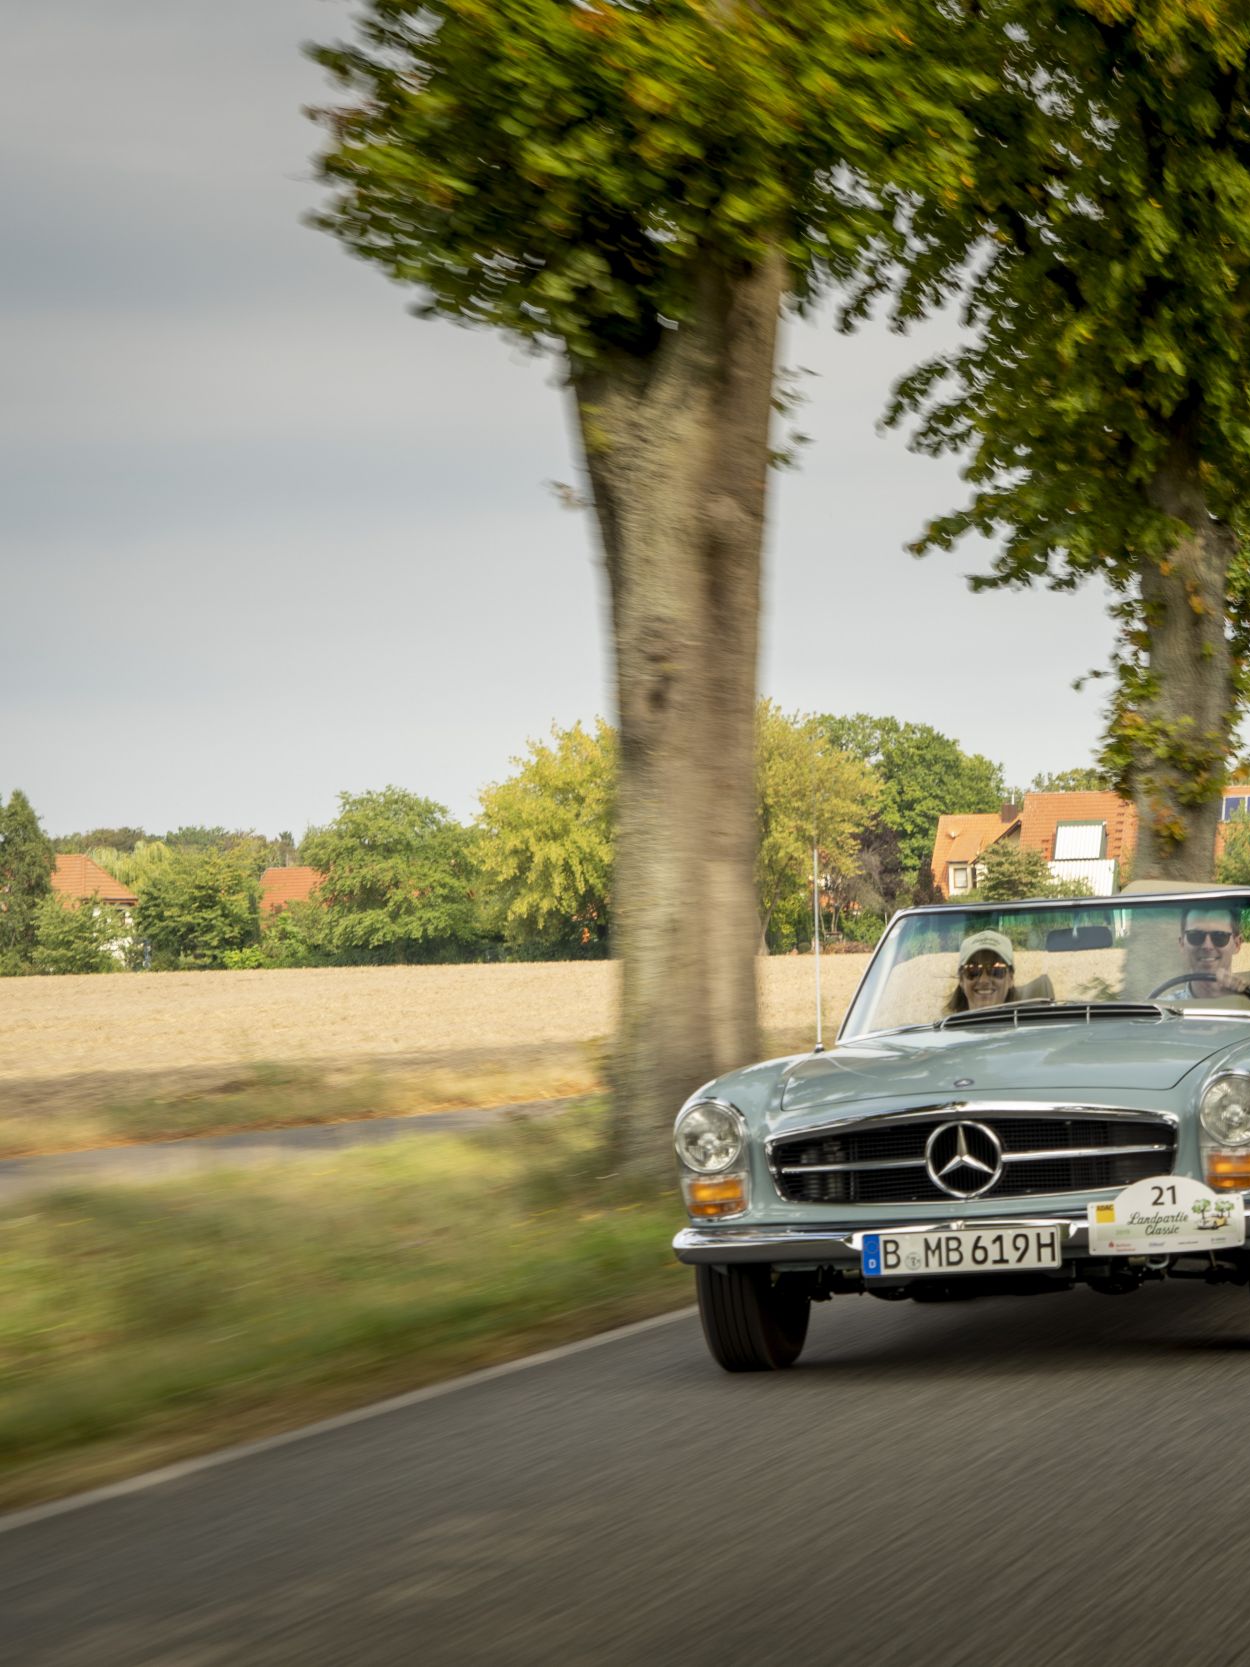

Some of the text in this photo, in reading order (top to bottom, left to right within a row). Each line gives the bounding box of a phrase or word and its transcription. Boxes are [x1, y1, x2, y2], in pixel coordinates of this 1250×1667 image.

[1151, 1185, 1177, 1206] 21
[1127, 1210, 1189, 1226] Landpartie
[1145, 1224, 1180, 1236] Classic
[883, 1239, 901, 1270] B
[923, 1236, 964, 1268] MB
